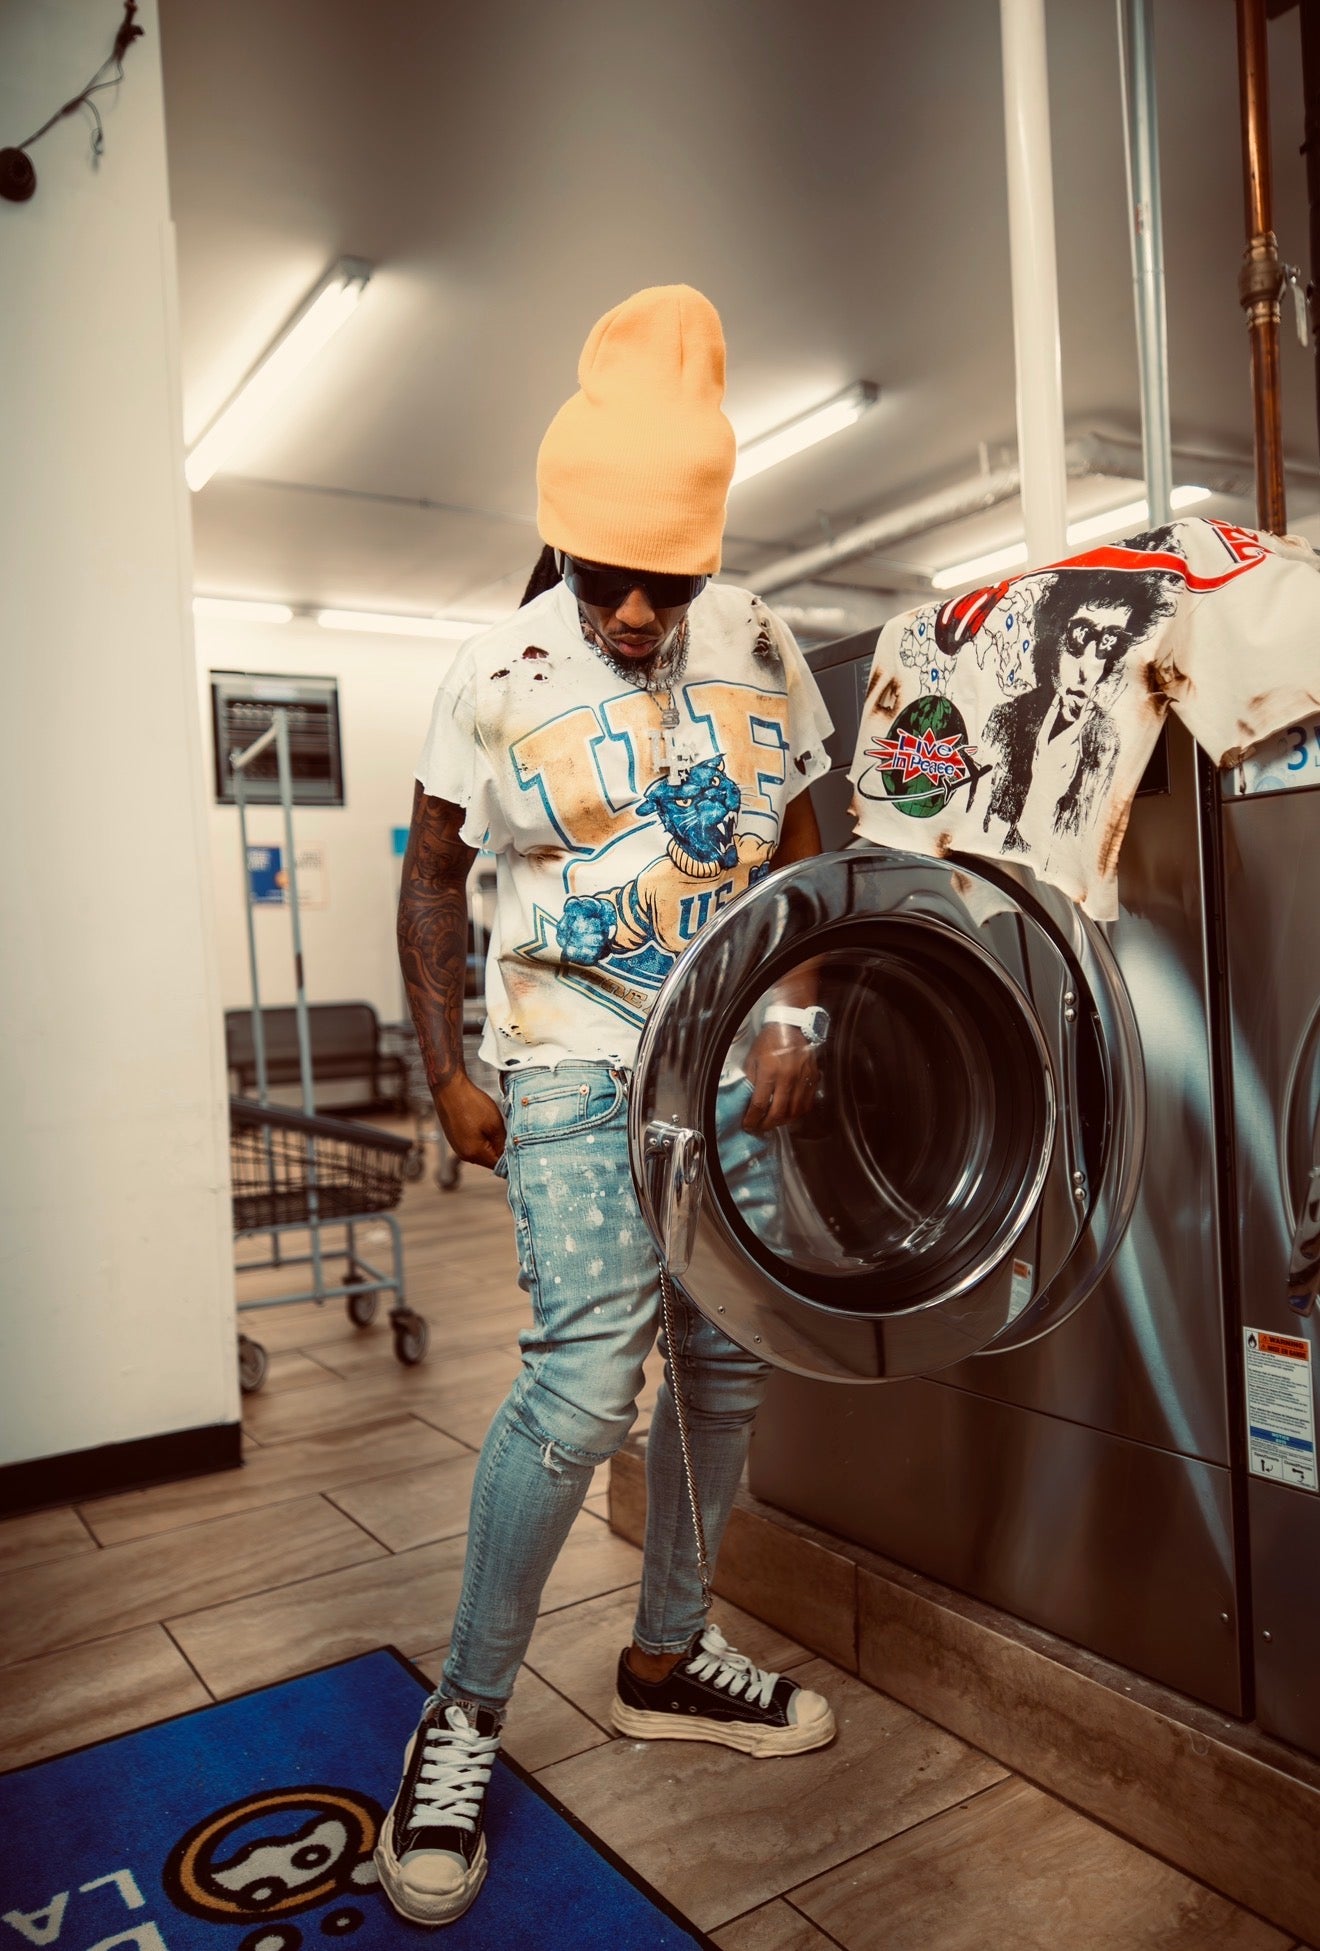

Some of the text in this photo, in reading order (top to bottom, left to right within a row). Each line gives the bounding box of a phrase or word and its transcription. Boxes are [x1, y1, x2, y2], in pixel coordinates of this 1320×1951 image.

[899, 734, 953, 757] Live
[909, 755, 955, 776] Peace
[1, 1869, 146, 1946] LA
